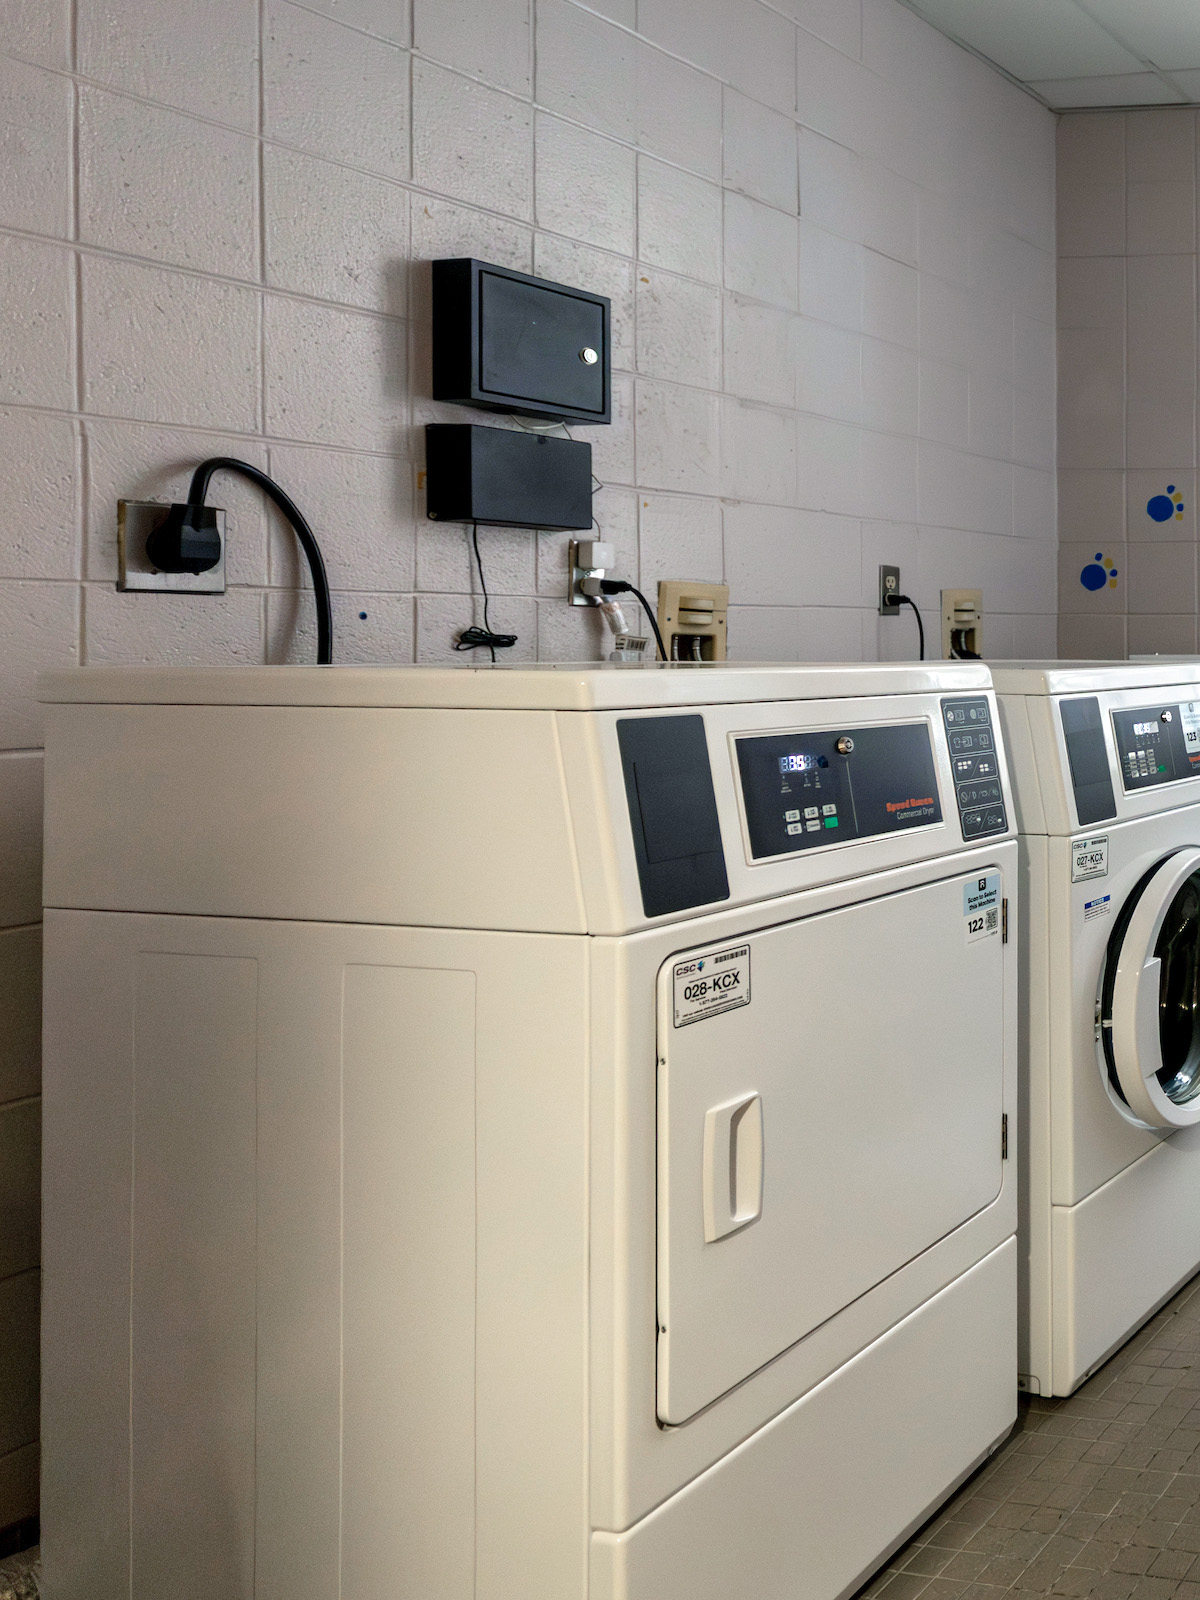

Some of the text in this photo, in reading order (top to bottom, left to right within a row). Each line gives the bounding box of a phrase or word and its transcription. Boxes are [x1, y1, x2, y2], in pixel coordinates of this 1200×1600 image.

[1187, 731, 1197, 741] 123
[886, 797, 934, 812] Speed Queen
[897, 807, 935, 820] Commercial Dryer
[1077, 852, 1104, 866] 027-KCX
[967, 895, 979, 904] Scan
[984, 889, 997, 898] Select
[968, 897, 996, 911] this Machine
[968, 917, 984, 934] 122
[676, 964, 696, 976] CSC
[684, 970, 740, 1000] 028-KCX
